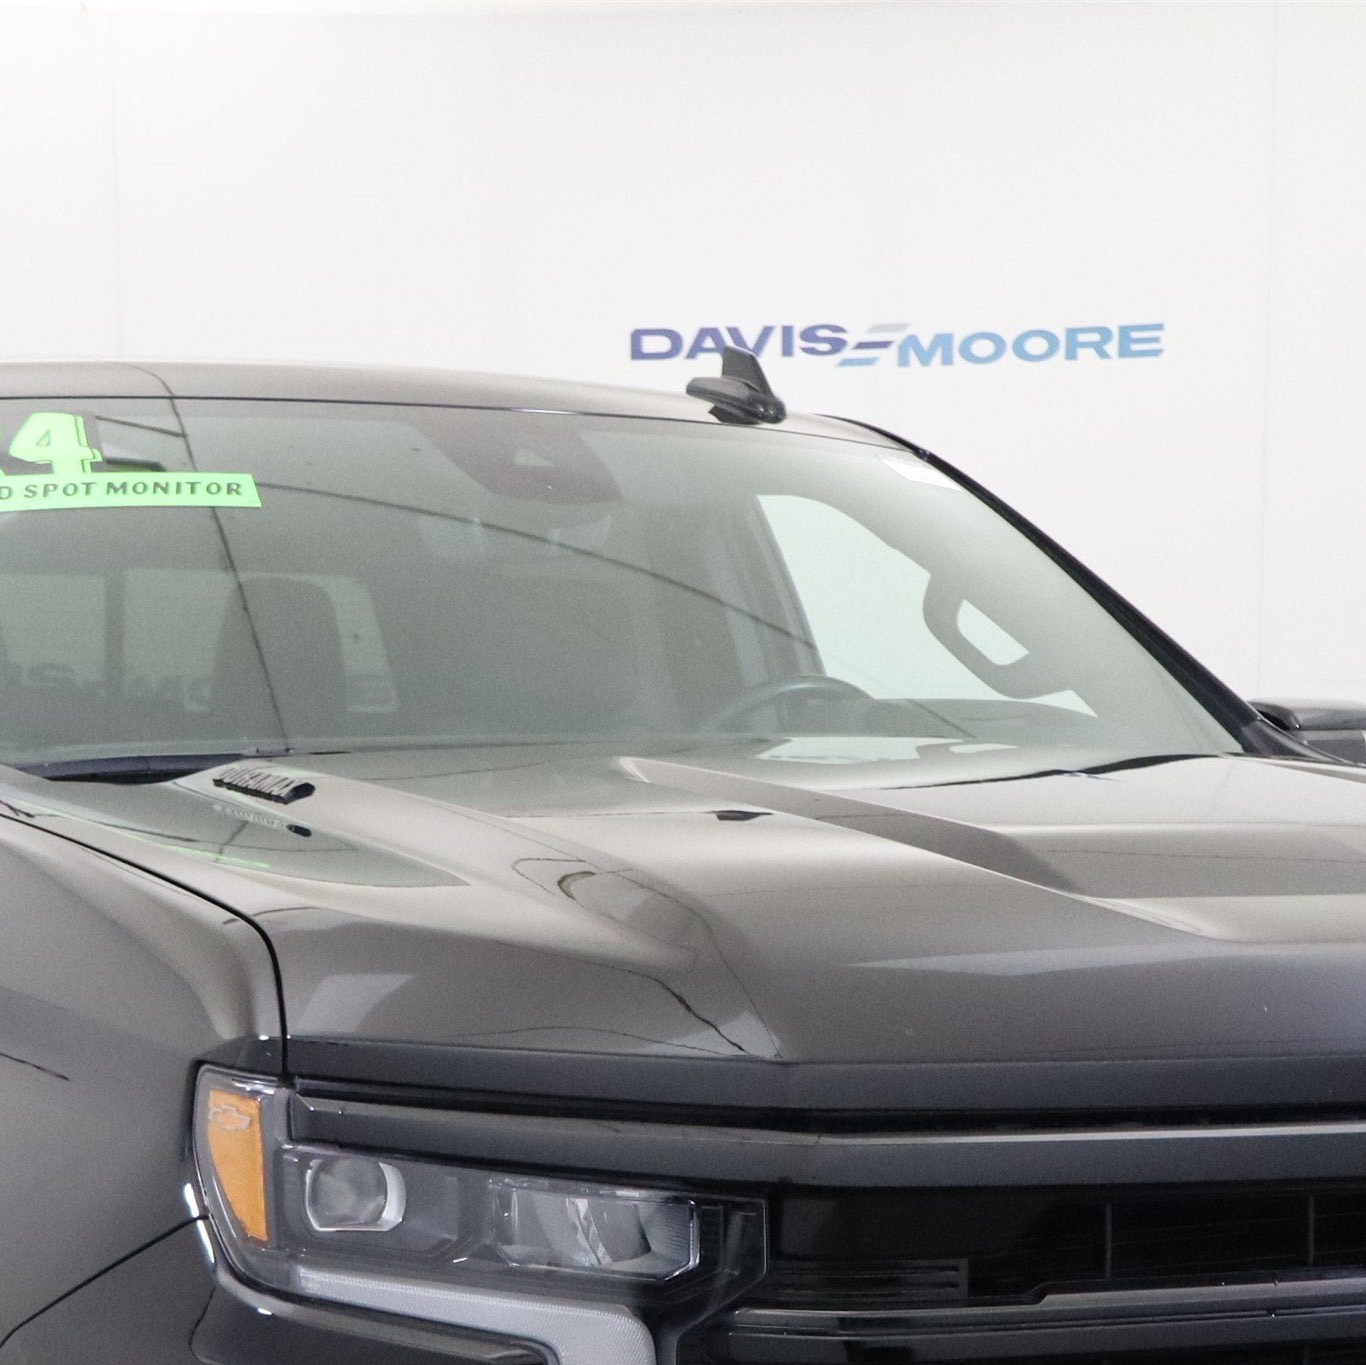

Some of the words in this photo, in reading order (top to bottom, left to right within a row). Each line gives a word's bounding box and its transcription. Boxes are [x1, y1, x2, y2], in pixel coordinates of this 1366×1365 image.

[630, 322, 850, 361] DAVIS
[895, 321, 1166, 368] MOORE
[24, 481, 97, 499] SPOT
[106, 480, 243, 497] MONITOR
